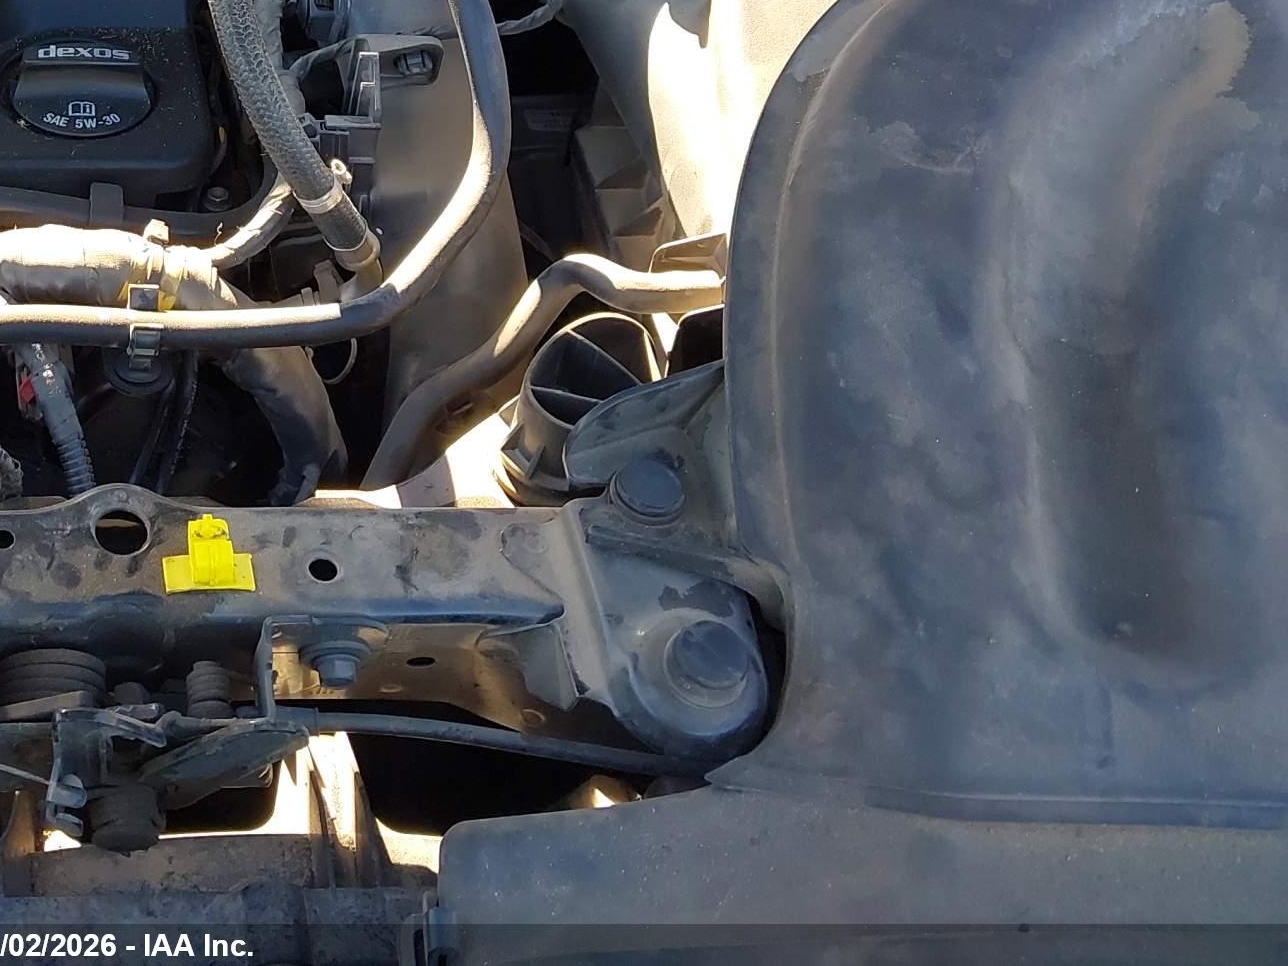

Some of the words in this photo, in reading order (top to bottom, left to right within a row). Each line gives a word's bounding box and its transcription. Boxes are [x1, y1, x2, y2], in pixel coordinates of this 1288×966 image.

[37, 44, 133, 60] dexos
[43, 112, 69, 127] SAE
[75, 113, 121, 129] 5W-30
